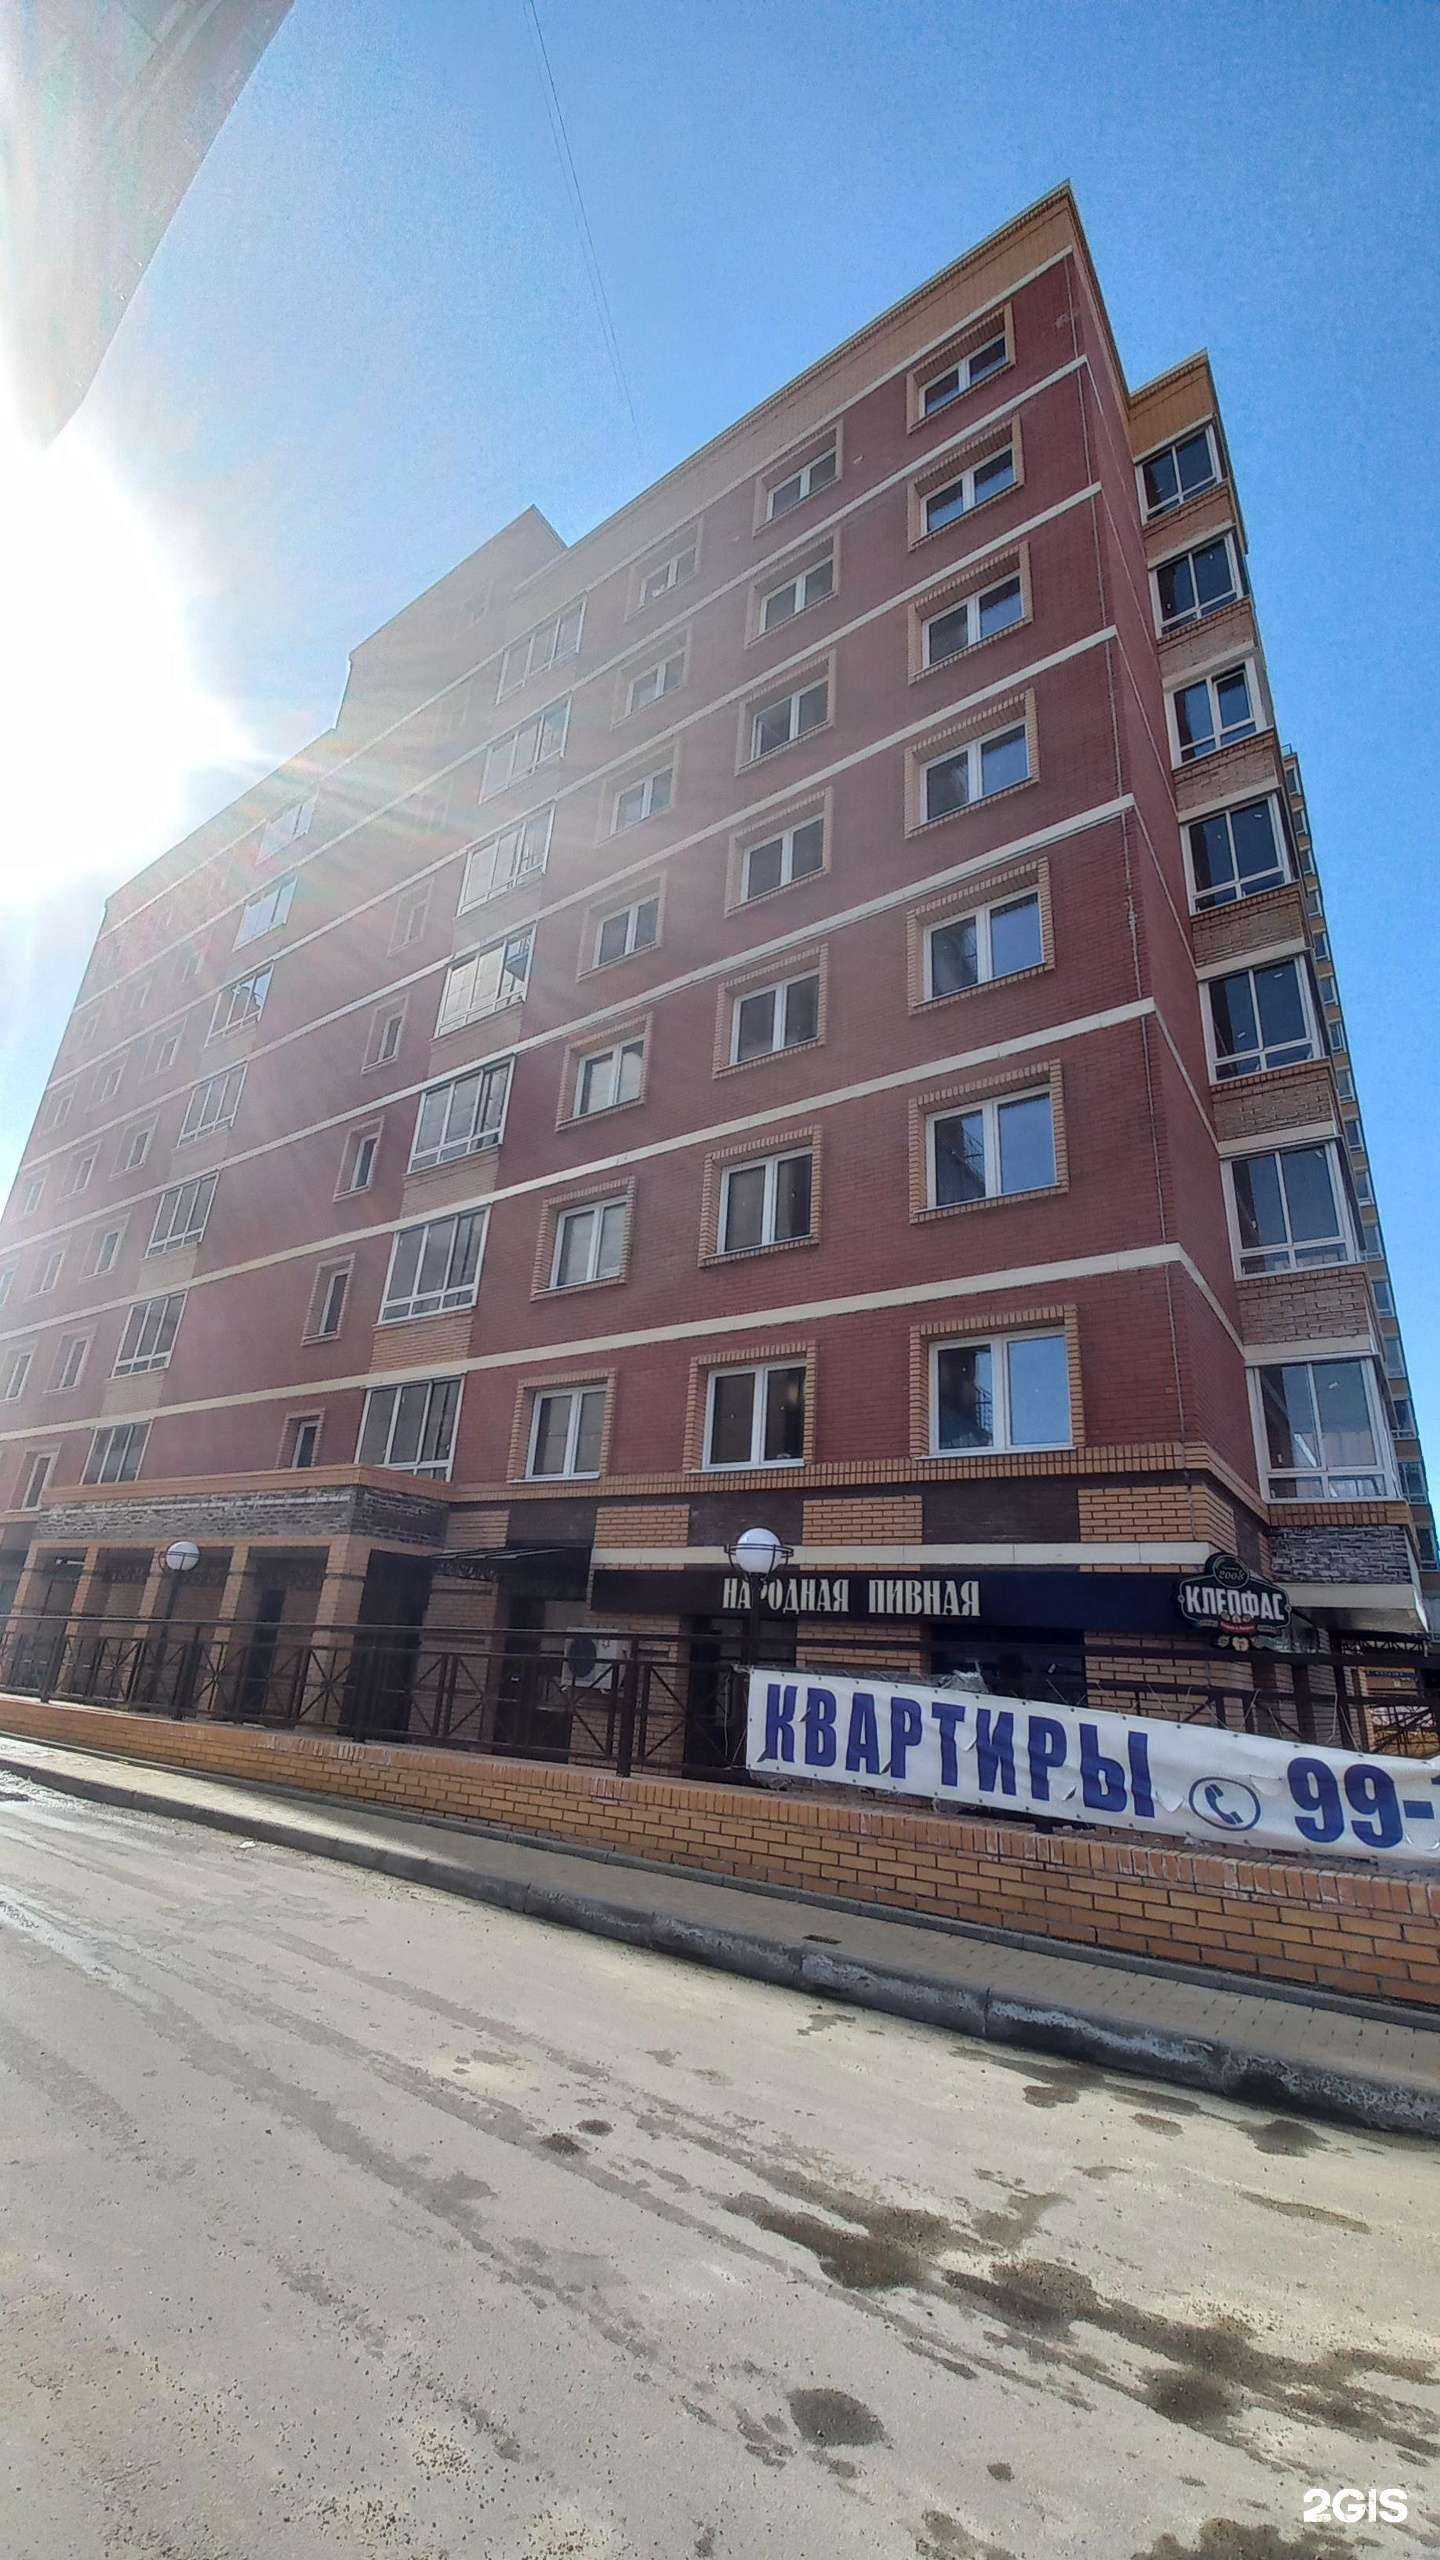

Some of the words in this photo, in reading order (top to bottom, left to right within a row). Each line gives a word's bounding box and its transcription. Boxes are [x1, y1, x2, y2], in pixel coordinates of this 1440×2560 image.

[868, 1579, 981, 1617] ПИВНАЯ
[765, 1683, 1156, 1819] КВАРТИРЫ
[1287, 1757, 1440, 1849] 99-
